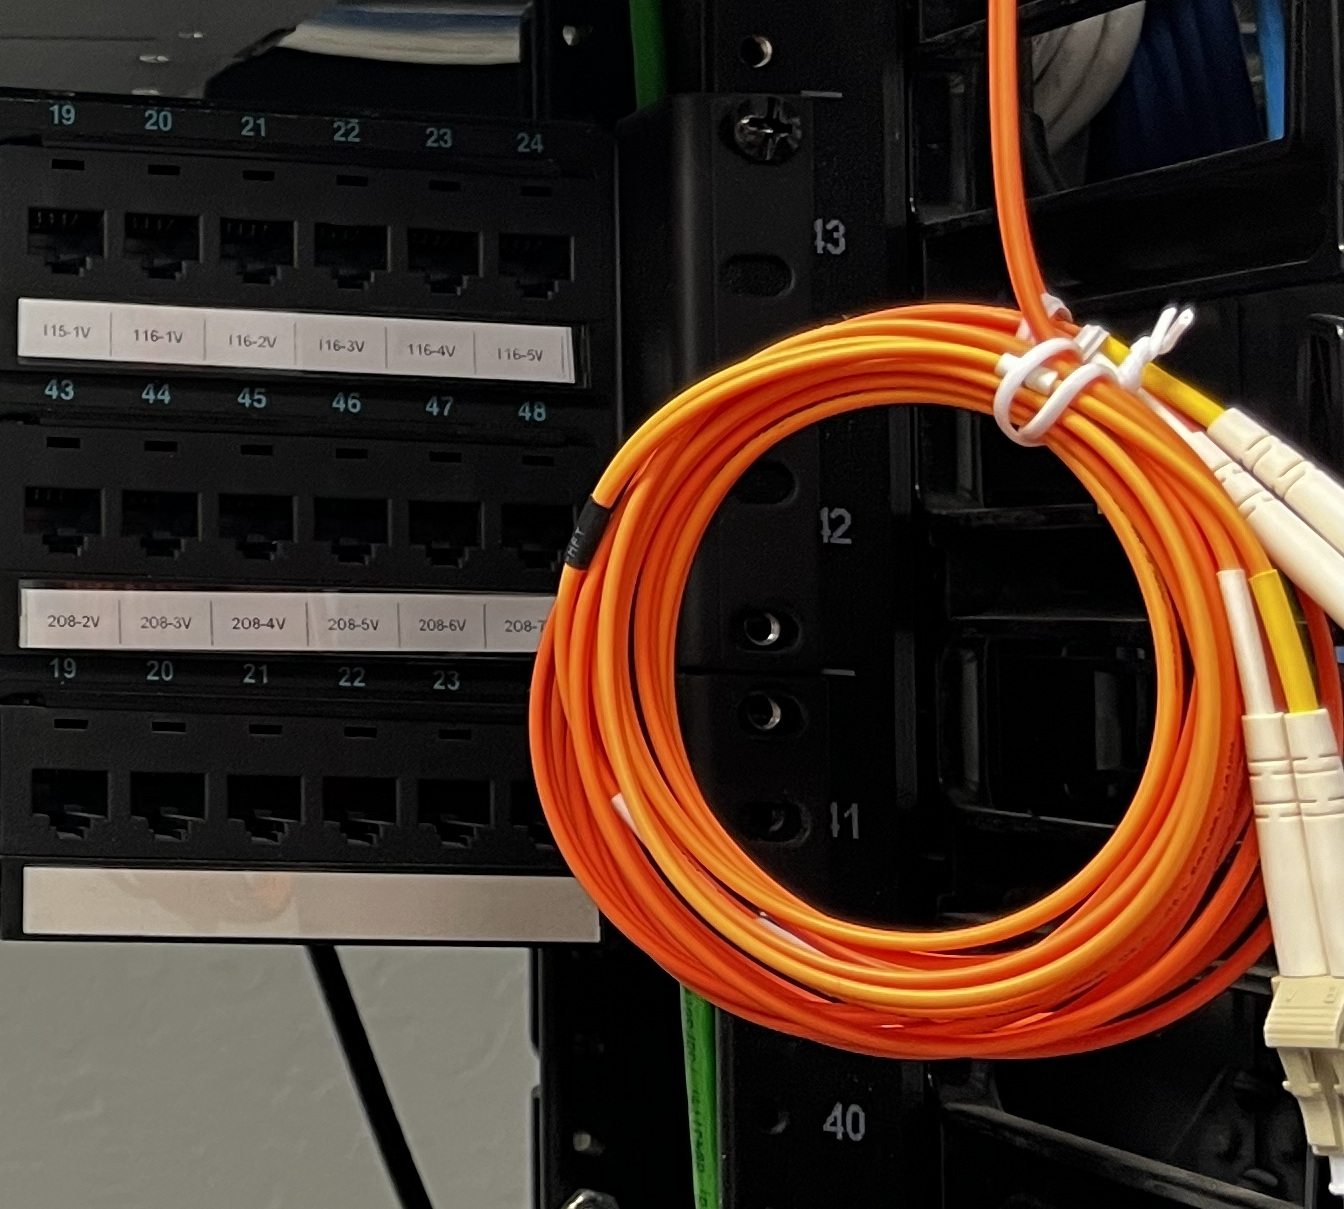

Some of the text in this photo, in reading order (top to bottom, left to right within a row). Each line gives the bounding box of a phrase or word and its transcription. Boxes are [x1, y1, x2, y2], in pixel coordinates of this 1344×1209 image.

[48, 104, 545, 154] 19 20 21 22 23 24
[43, 323, 544, 362] 115-1V 116-1V 116-2V 116-3V 116-4V 116-5V
[44, 379, 547, 422] 43 44 45 46 47 48
[47, 614, 547, 633] 208-2V 208-3V 208-4V 208-5V 208-6V 208-7
[49, 657, 461, 691] 19 20 21 22 23
[823, 1101, 866, 1142] 40
